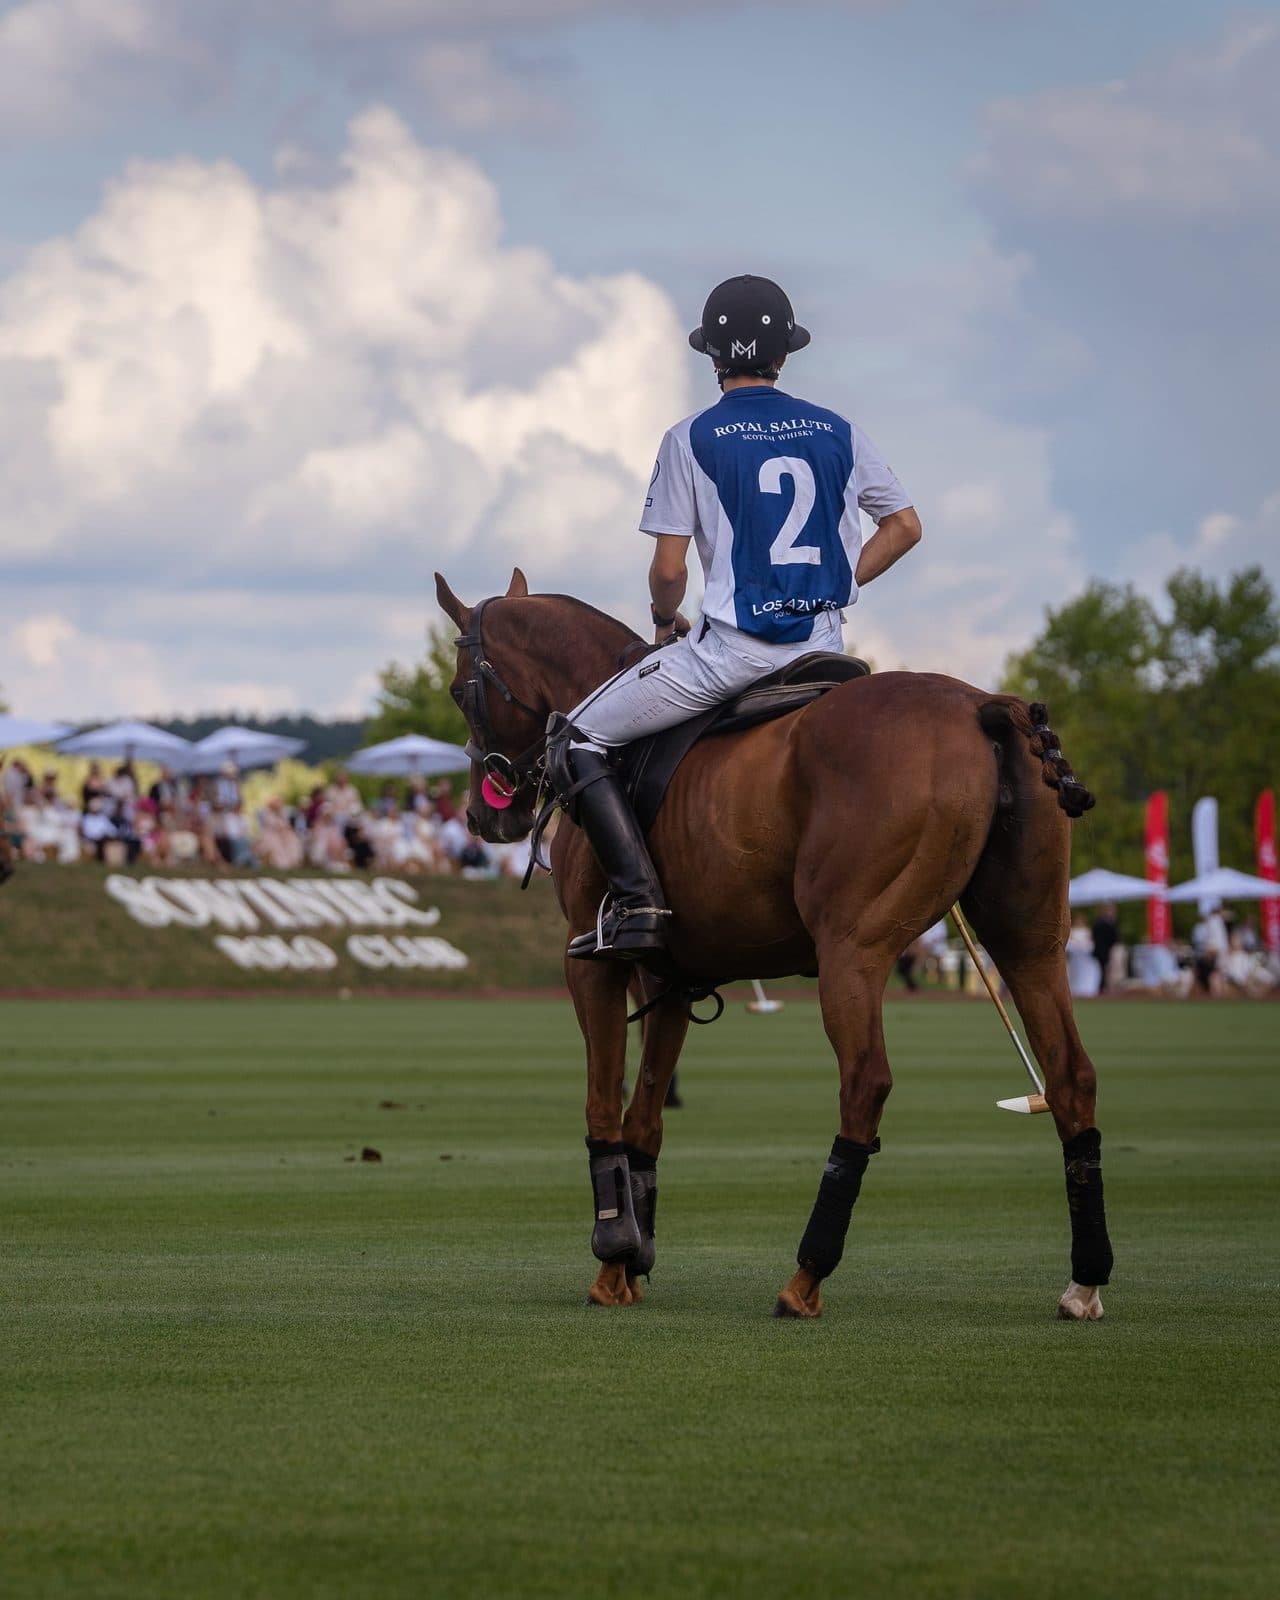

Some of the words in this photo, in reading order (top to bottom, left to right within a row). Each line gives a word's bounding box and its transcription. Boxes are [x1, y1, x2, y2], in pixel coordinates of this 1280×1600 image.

[714, 421, 767, 437] ROYAL
[770, 419, 833, 432] SALUTE
[778, 430, 814, 440] WHISKY
[758, 455, 821, 565] 2
[752, 600, 782, 616] LOS
[785, 598, 837, 611] AZUES
